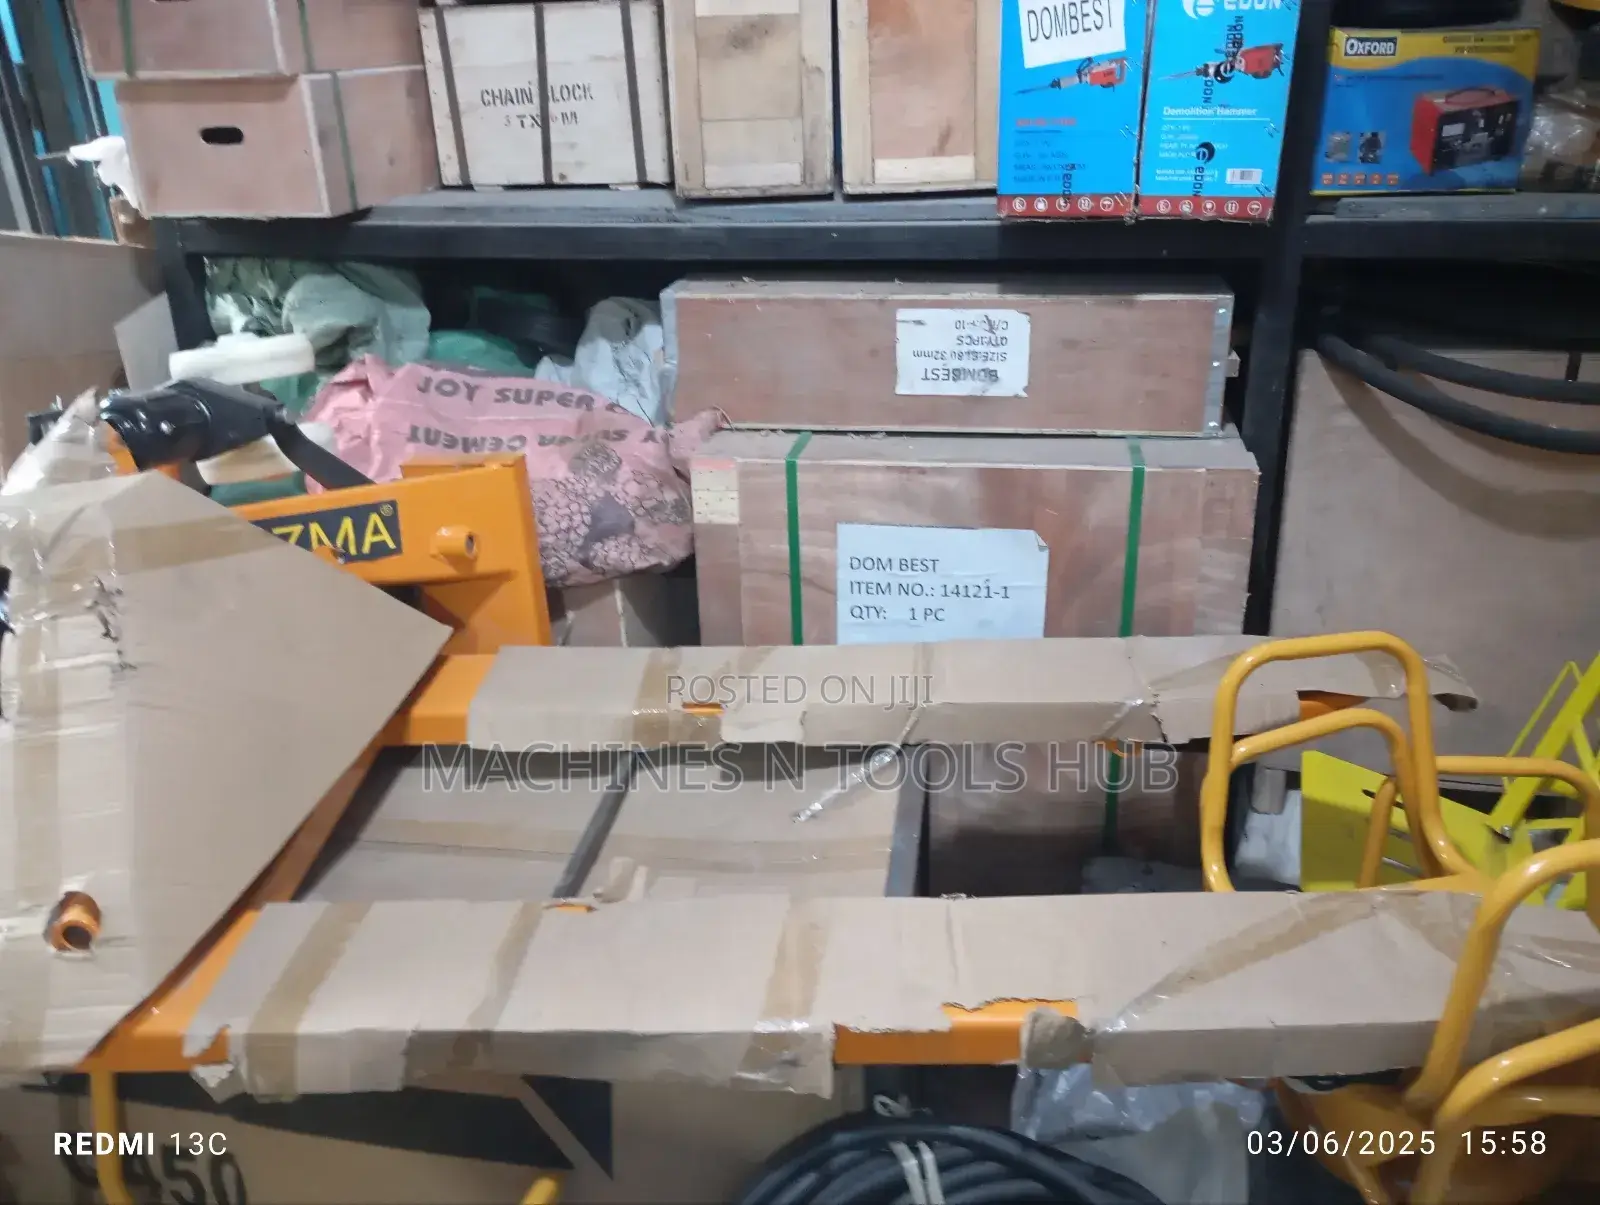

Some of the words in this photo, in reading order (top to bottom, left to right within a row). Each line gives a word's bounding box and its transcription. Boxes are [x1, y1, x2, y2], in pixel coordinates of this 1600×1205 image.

[1027, 0, 1113, 42] DOMBEST
[480, 86, 534, 107] CHAIN
[548, 83, 594, 103] LOCK
[416, 376, 481, 402] JOY
[493, 387, 595, 411] SUPER
[849, 556, 892, 571] DOM
[899, 557, 940, 572] BEST
[849, 581, 892, 596] ITEM
[898, 583, 935, 597] NO.:
[940, 583, 1010, 599] 14121-1
[849, 604, 887, 620] QTY:
[908, 607, 918, 621] 1
[923, 607, 945, 622] PC
